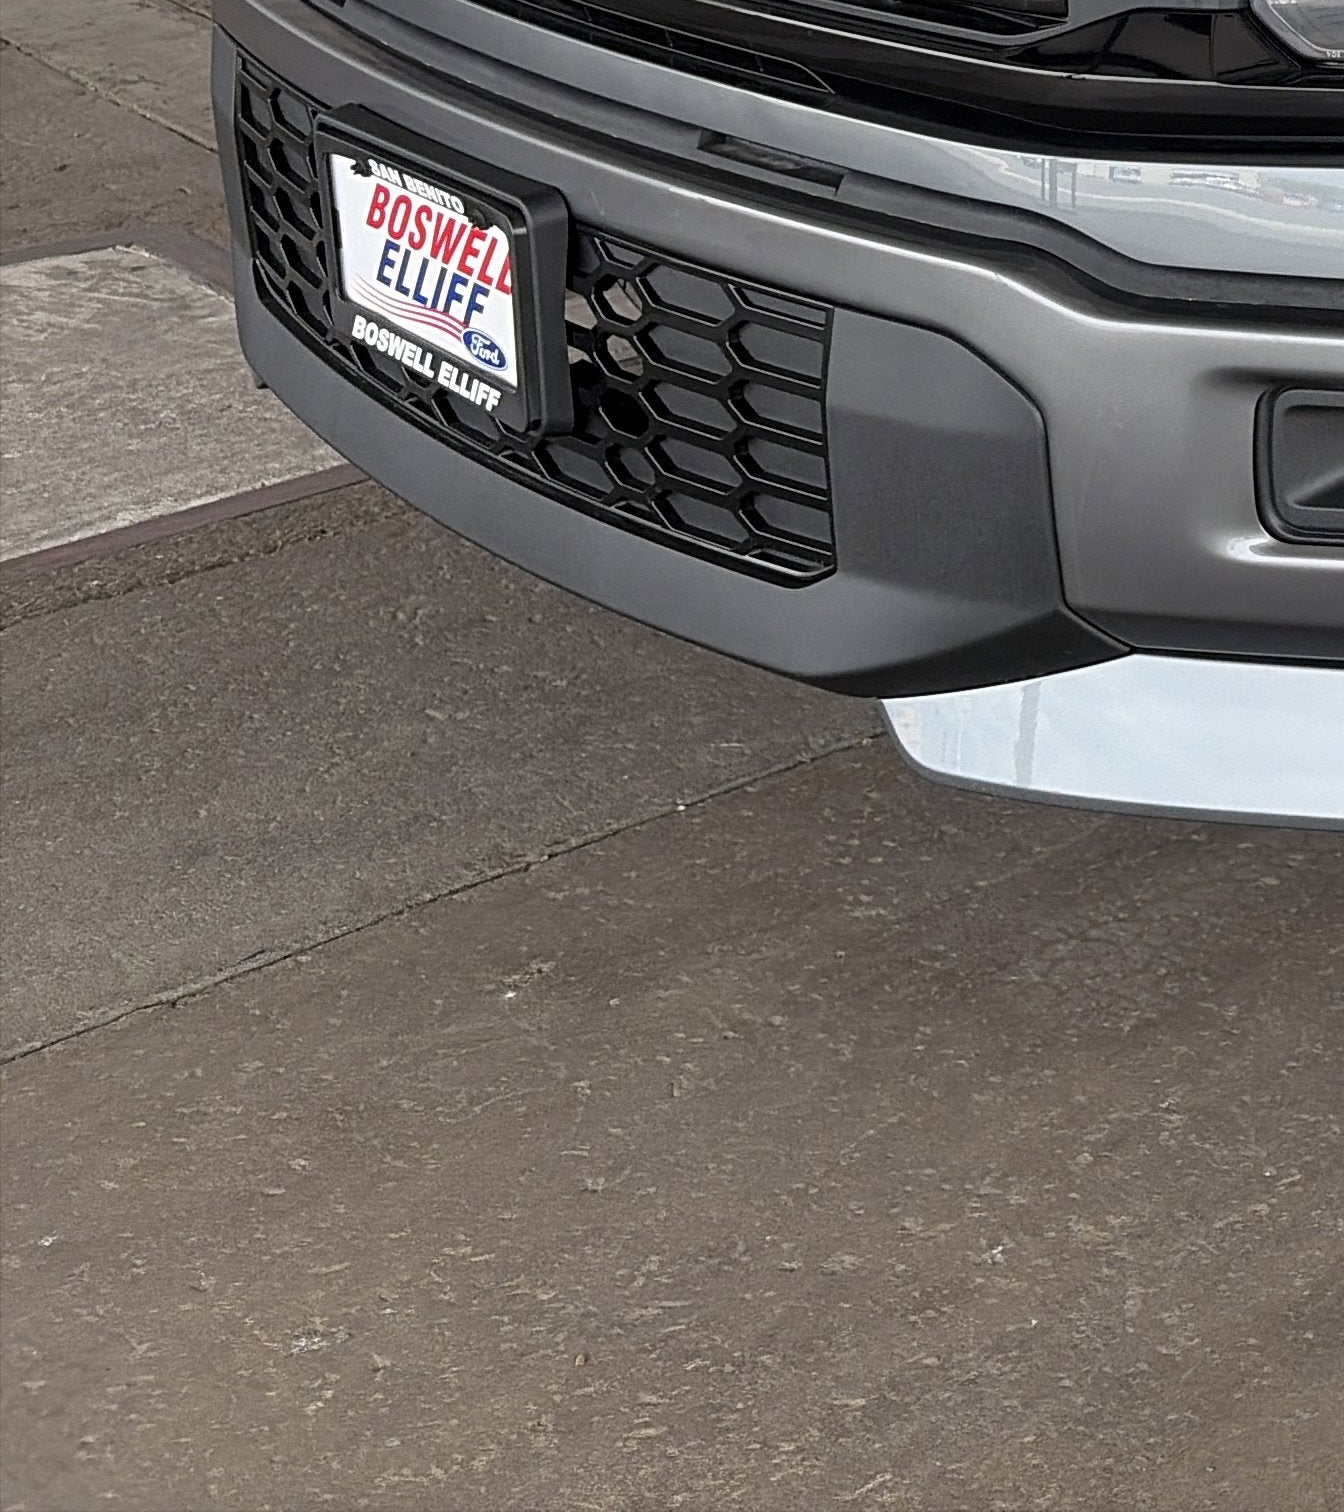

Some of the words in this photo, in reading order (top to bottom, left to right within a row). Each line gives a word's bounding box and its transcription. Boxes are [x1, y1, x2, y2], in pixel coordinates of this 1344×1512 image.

[368, 159, 403, 188] SAN
[405, 172, 465, 214] BENITO
[376, 239, 490, 327] ELLIFF
[352, 315, 435, 380] BOSWELL
[437, 364, 501, 412] ELLIFF
[471, 333, 501, 367] Ford
